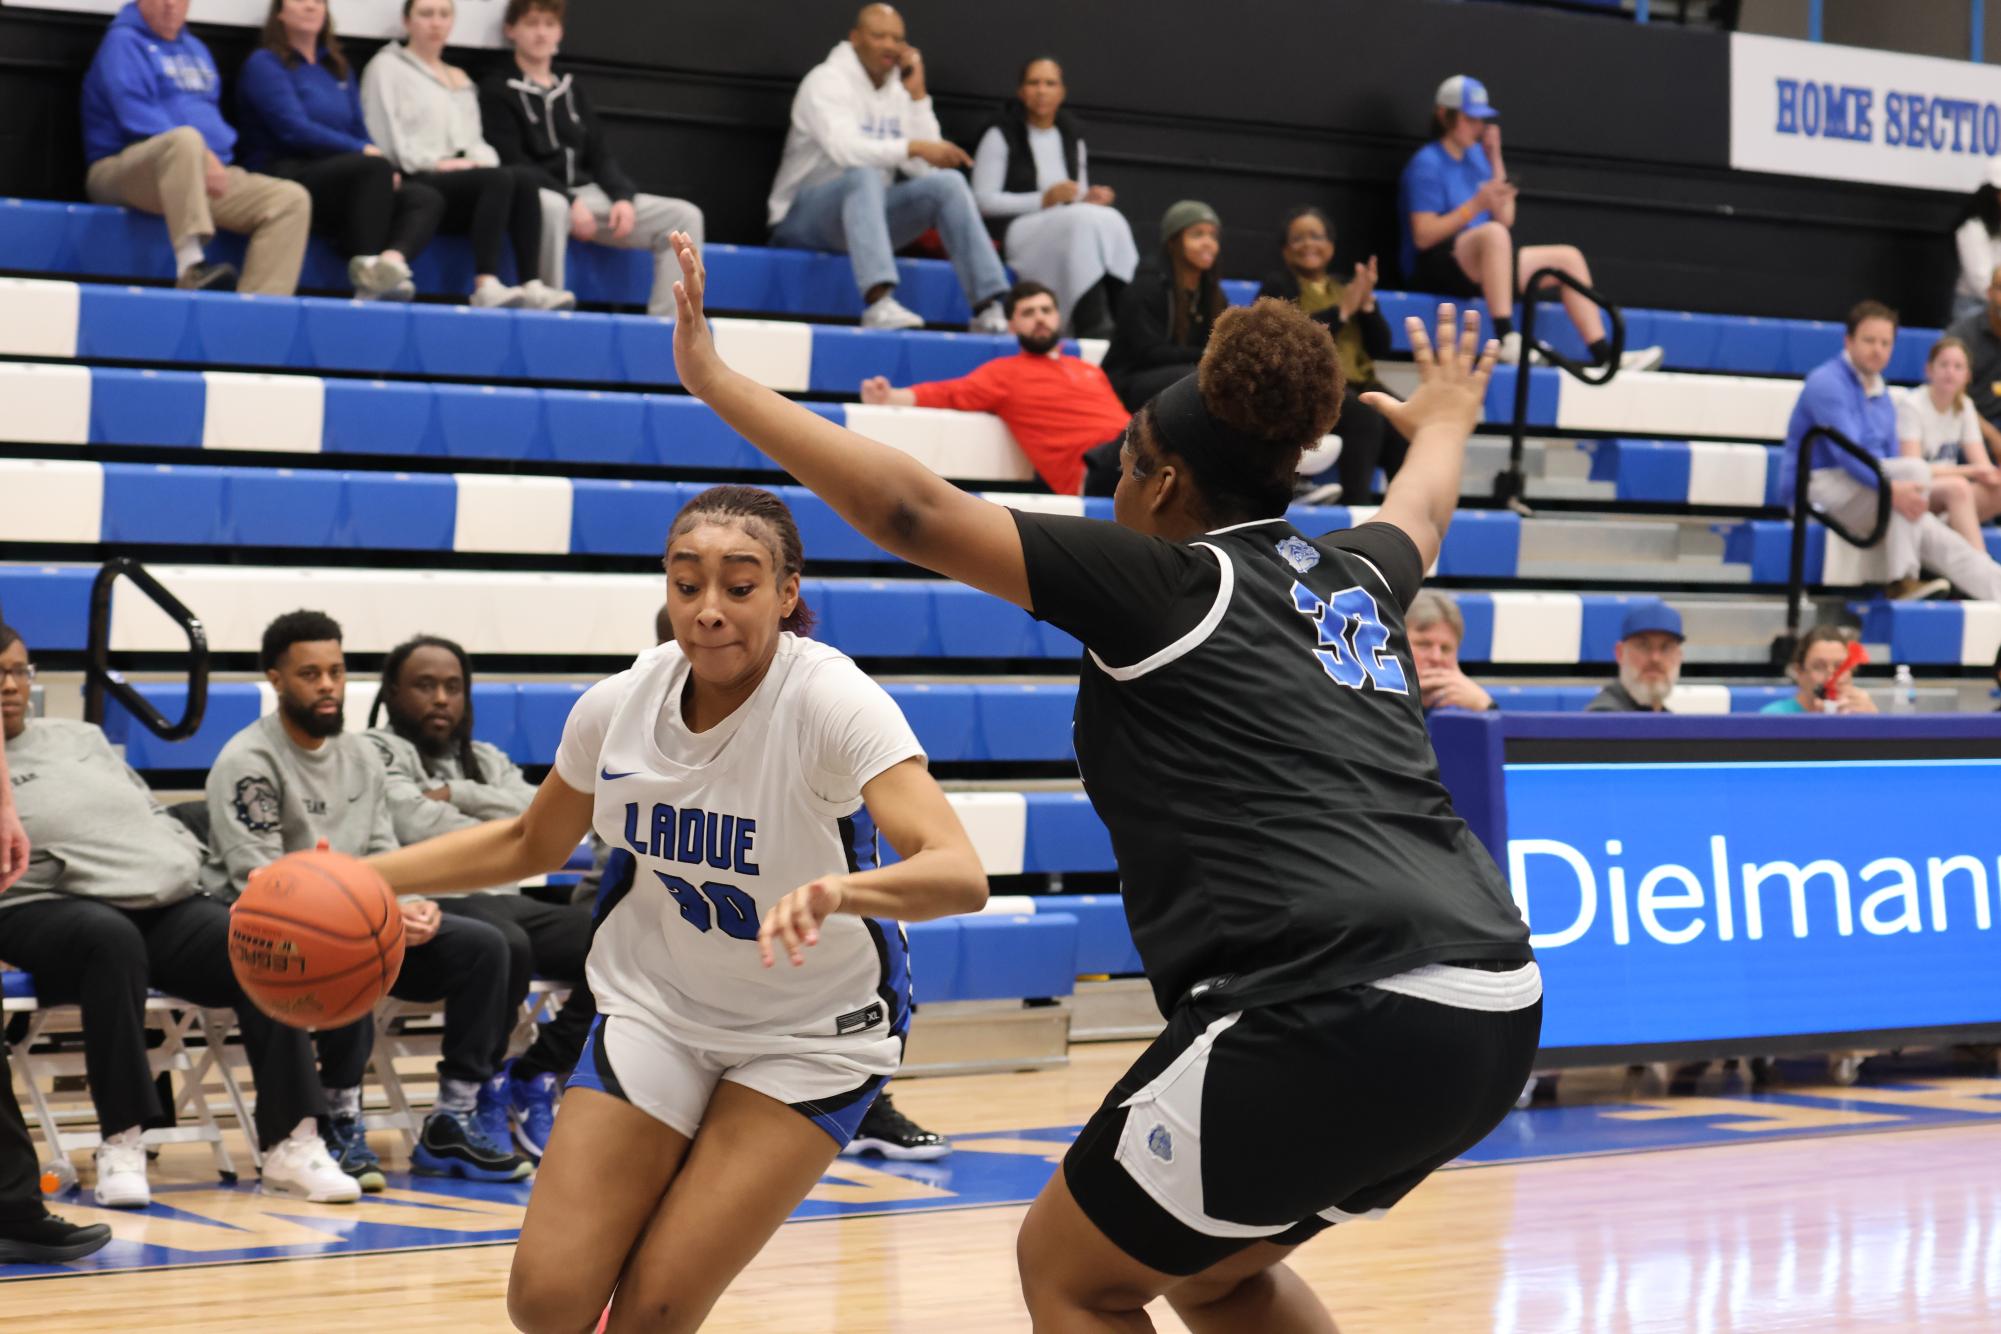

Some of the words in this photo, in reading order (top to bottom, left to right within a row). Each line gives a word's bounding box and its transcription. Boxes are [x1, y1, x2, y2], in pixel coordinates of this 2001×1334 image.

[1776, 78, 1873, 142] HOME
[1885, 90, 2000, 157] SECTIO
[1290, 579, 1409, 696] 32
[624, 802, 760, 876] LADUE
[653, 869, 761, 941] 30
[1507, 834, 2001, 949] Dielman
[866, 1010, 880, 1022] XL
